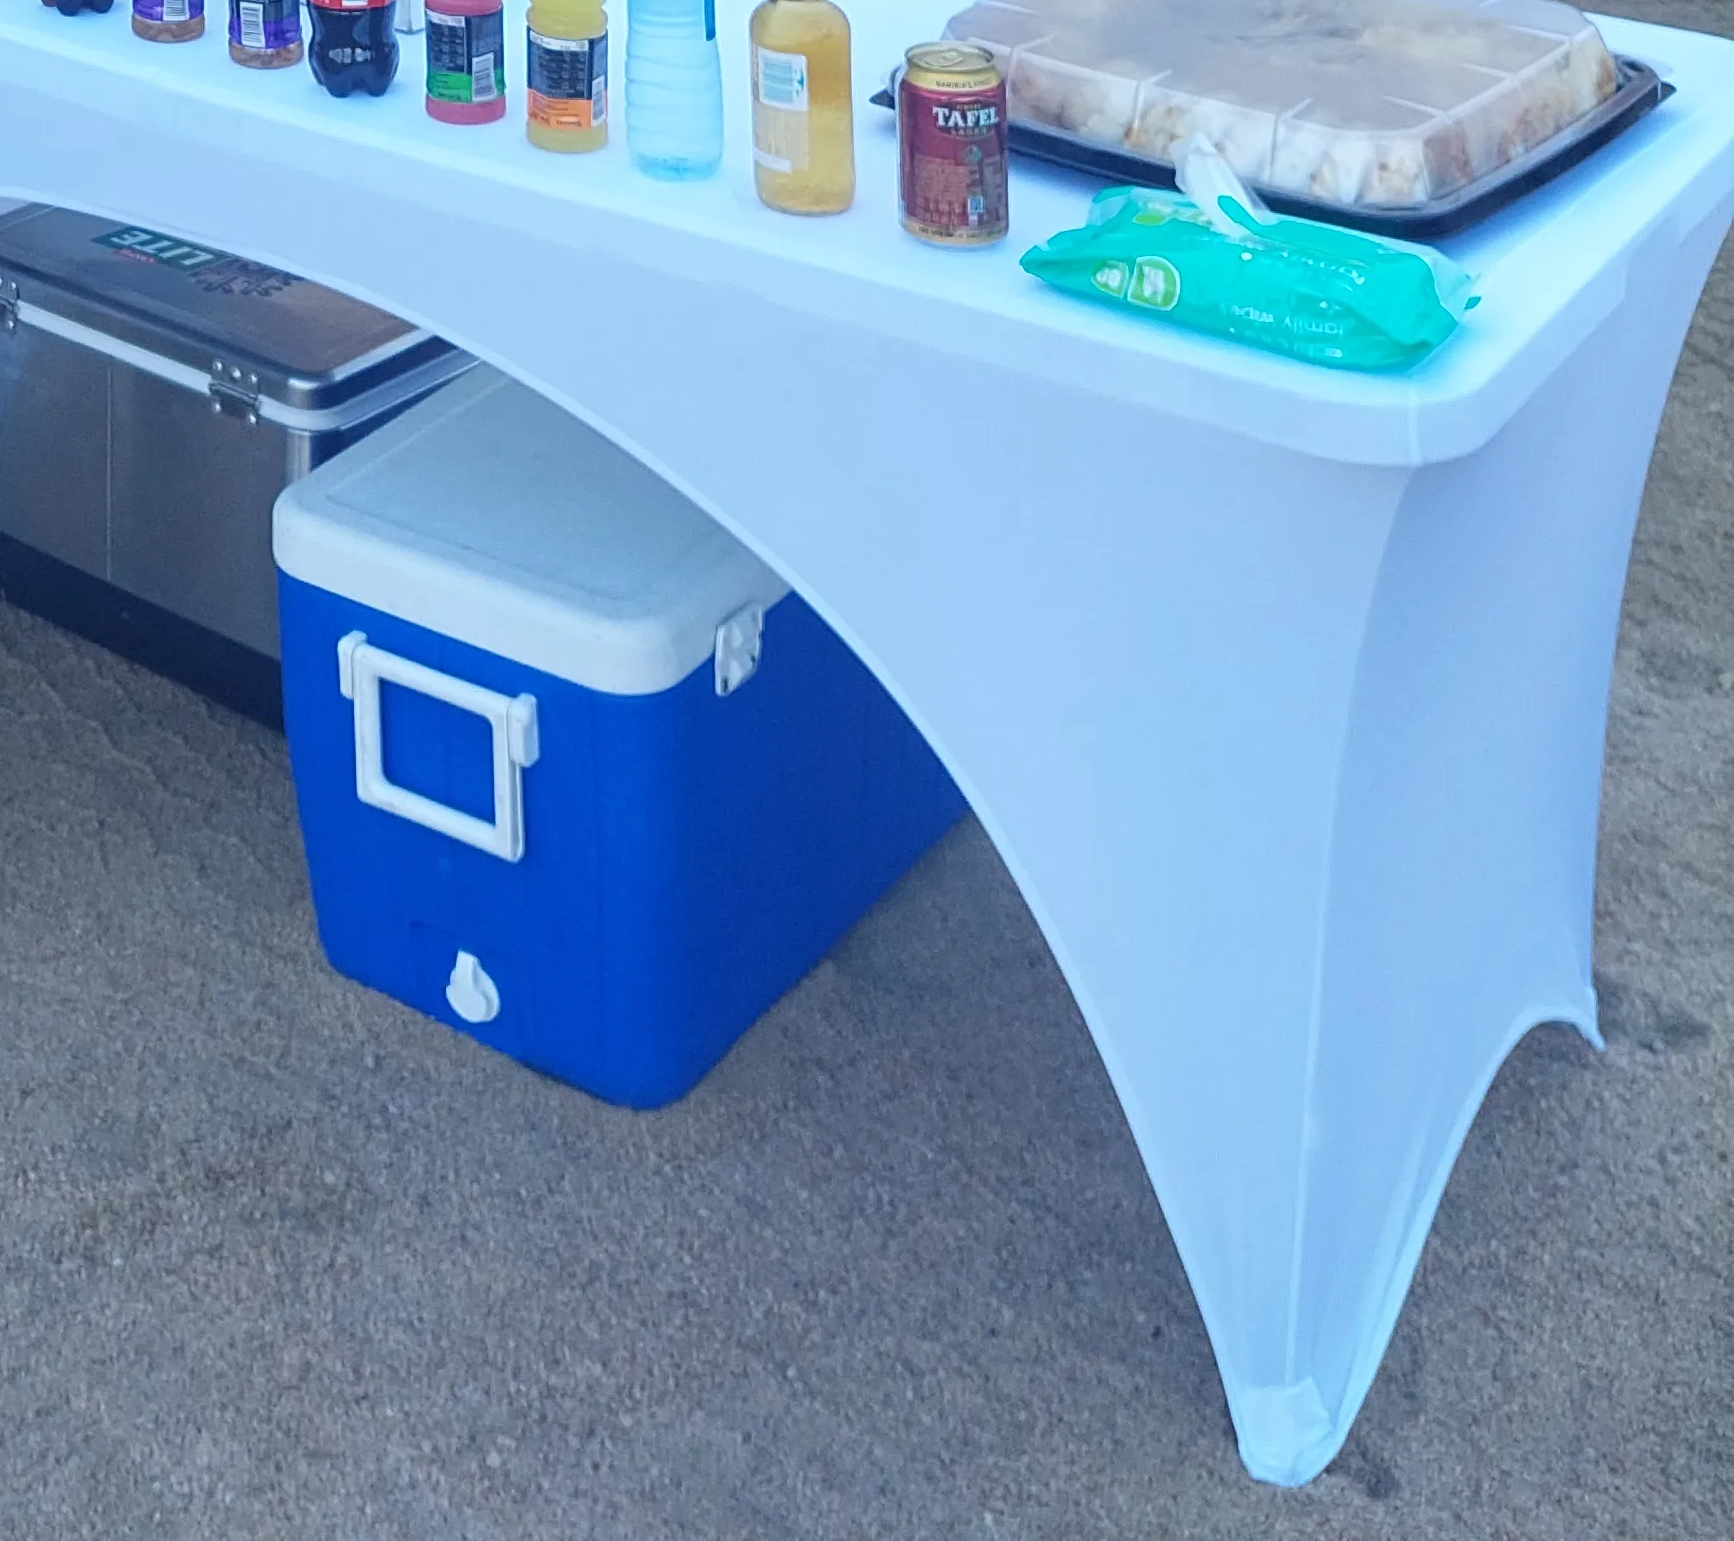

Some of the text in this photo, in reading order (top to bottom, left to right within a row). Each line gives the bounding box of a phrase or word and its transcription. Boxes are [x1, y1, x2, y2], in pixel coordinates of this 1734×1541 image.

[931, 106, 999, 128] TAFEL
[110, 230, 215, 266] LITE
[1284, 315, 1344, 336] family
